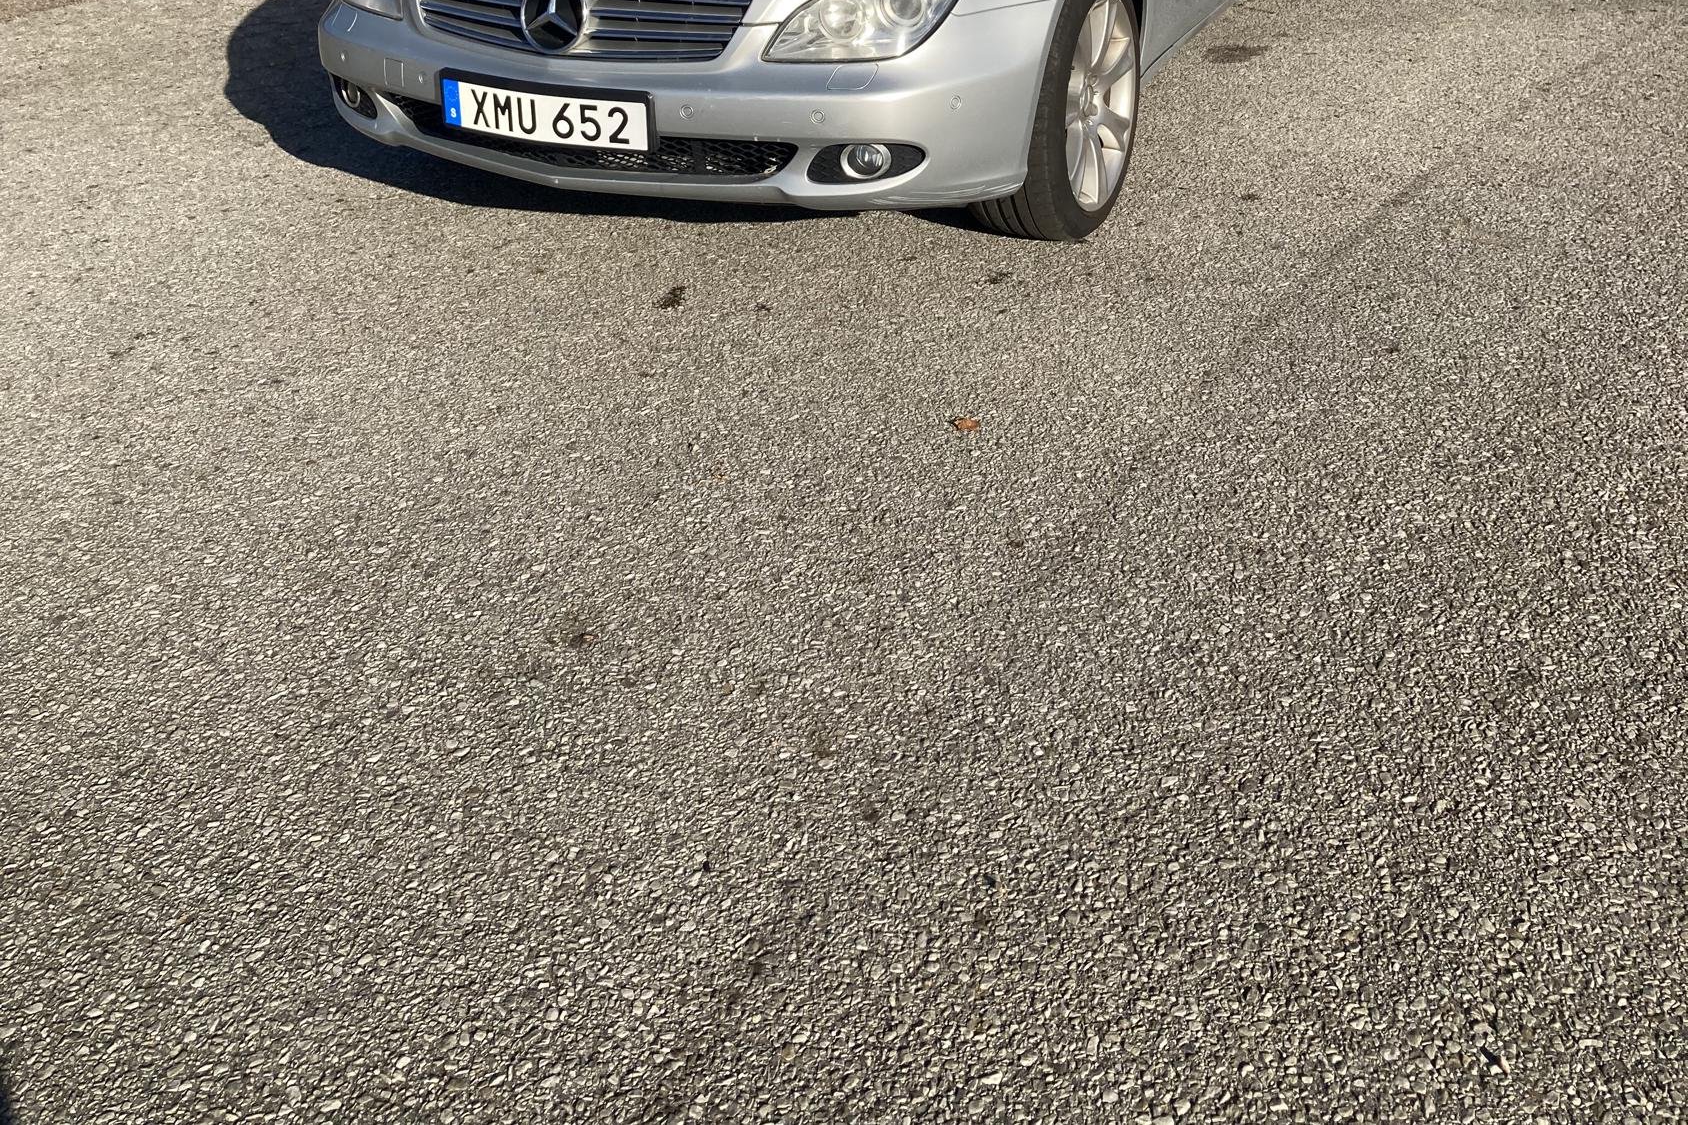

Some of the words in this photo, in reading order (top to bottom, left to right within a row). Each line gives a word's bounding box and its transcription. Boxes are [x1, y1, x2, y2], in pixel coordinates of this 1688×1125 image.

[450, 107, 457, 118] S
[471, 88, 537, 135] XMU
[552, 102, 631, 145] 652
